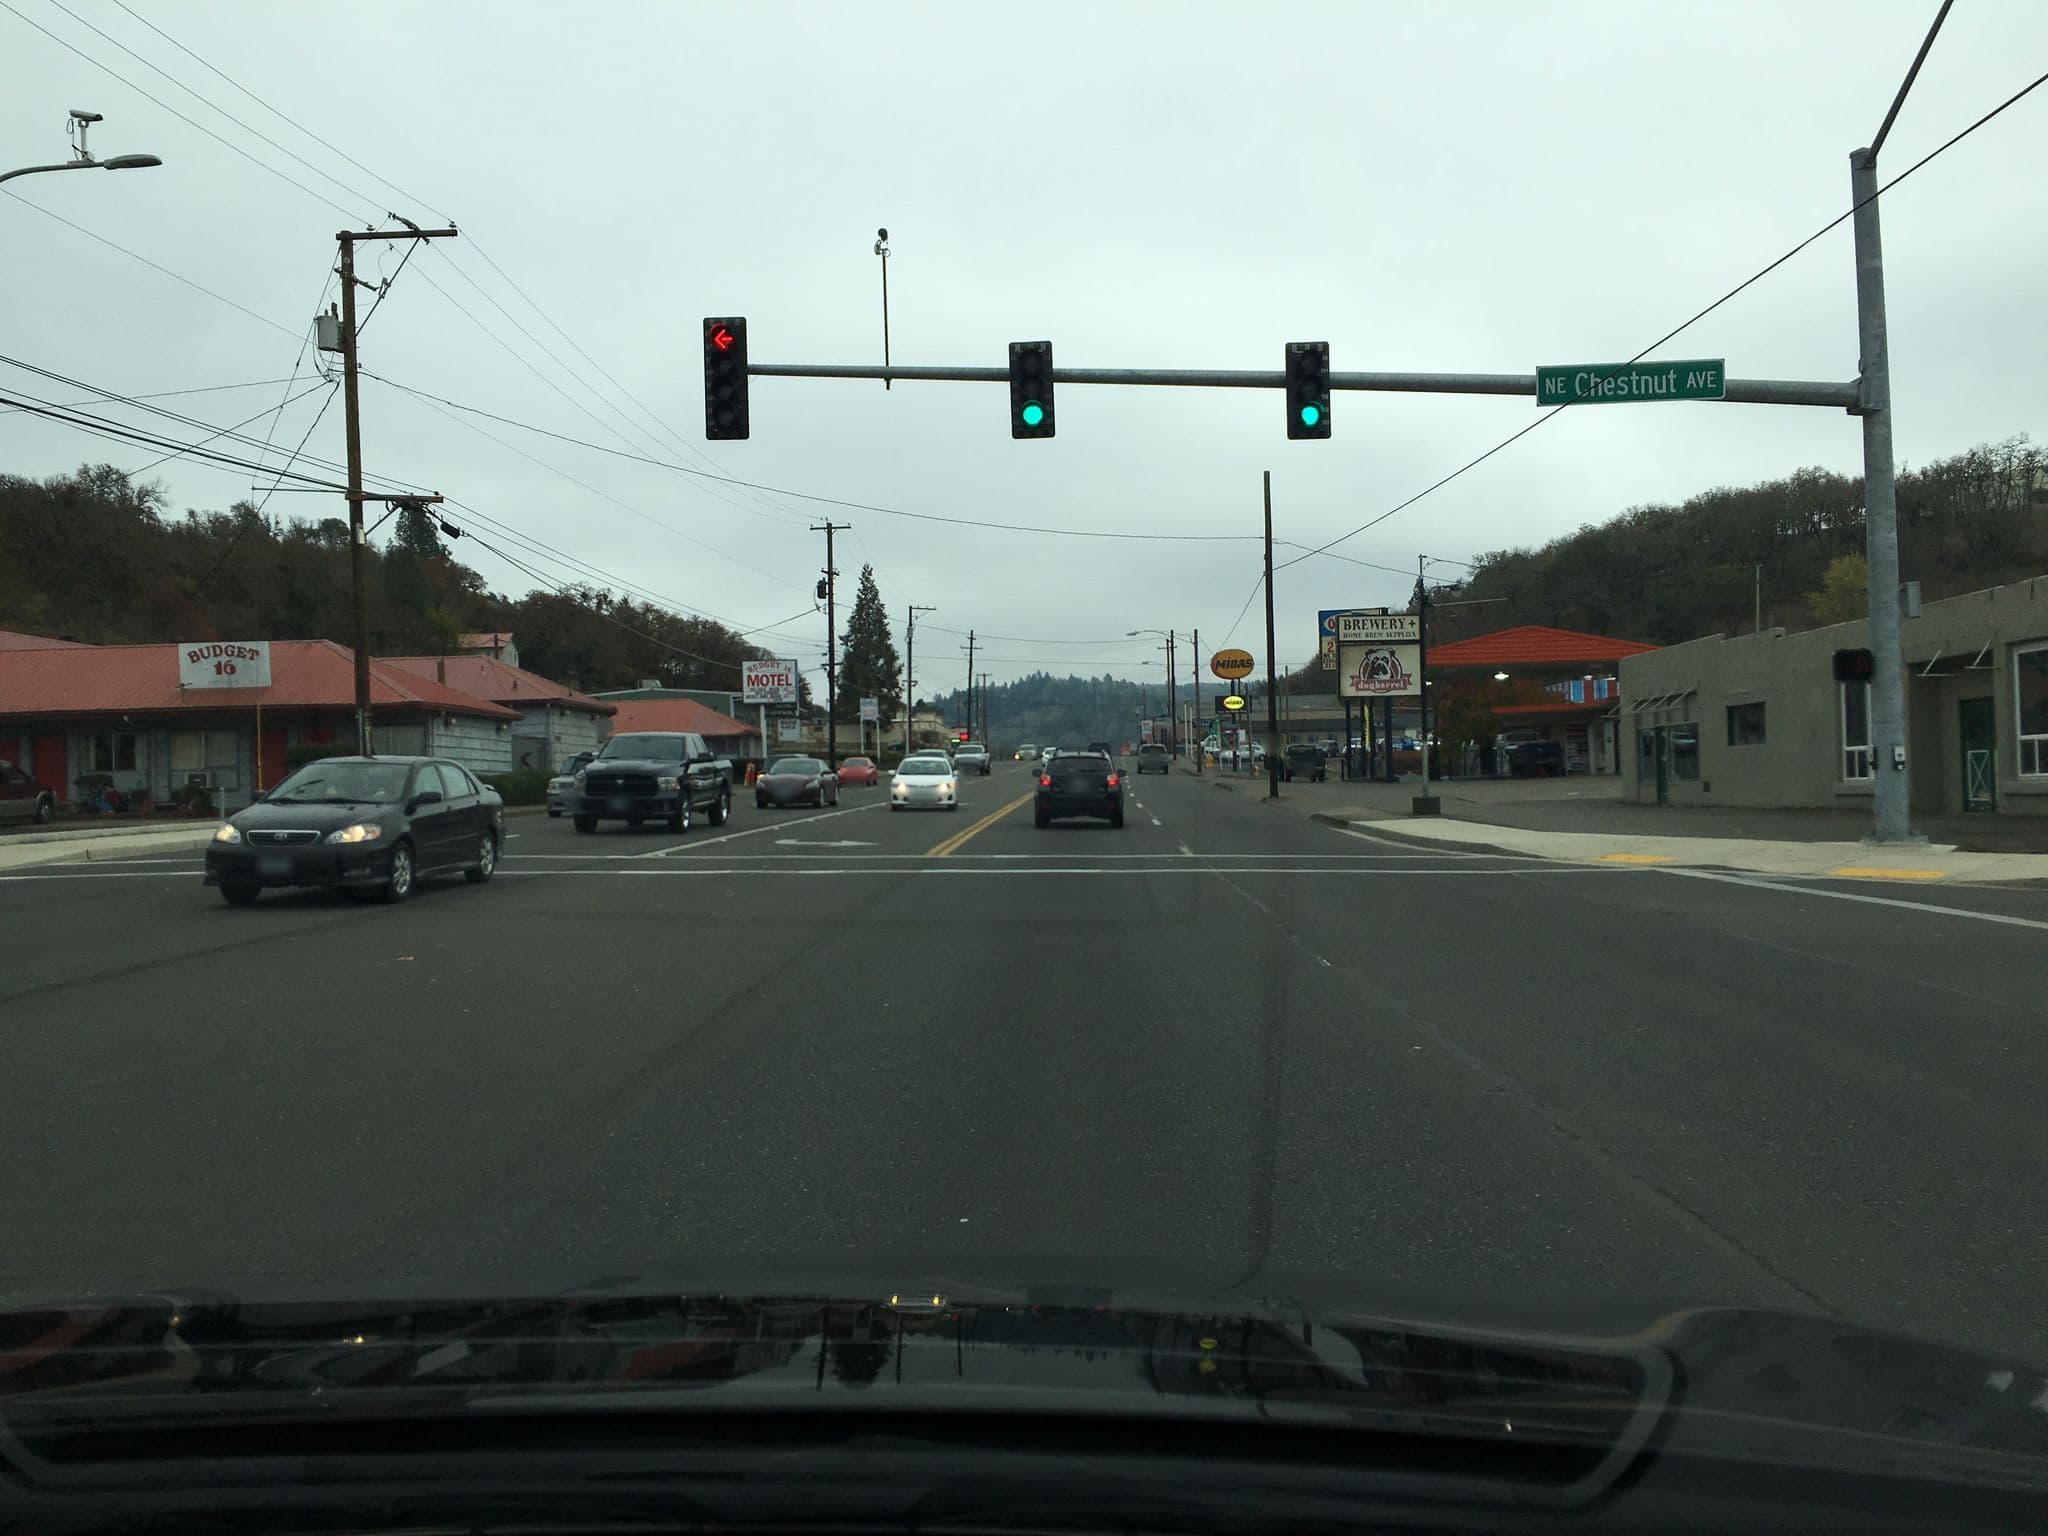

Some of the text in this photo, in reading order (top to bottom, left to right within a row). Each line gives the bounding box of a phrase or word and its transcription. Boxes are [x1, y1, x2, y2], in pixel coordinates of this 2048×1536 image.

[1545, 369, 1717, 397] NE Chestnut AVE
[1343, 618, 1406, 630] BREWERY
[187, 644, 260, 664] BUDGET
[214, 660, 237, 676] 16
[747, 661, 780, 672] BUDGET
[1215, 658, 1252, 670] MIDAS
[747, 674, 792, 686] MOTEL
